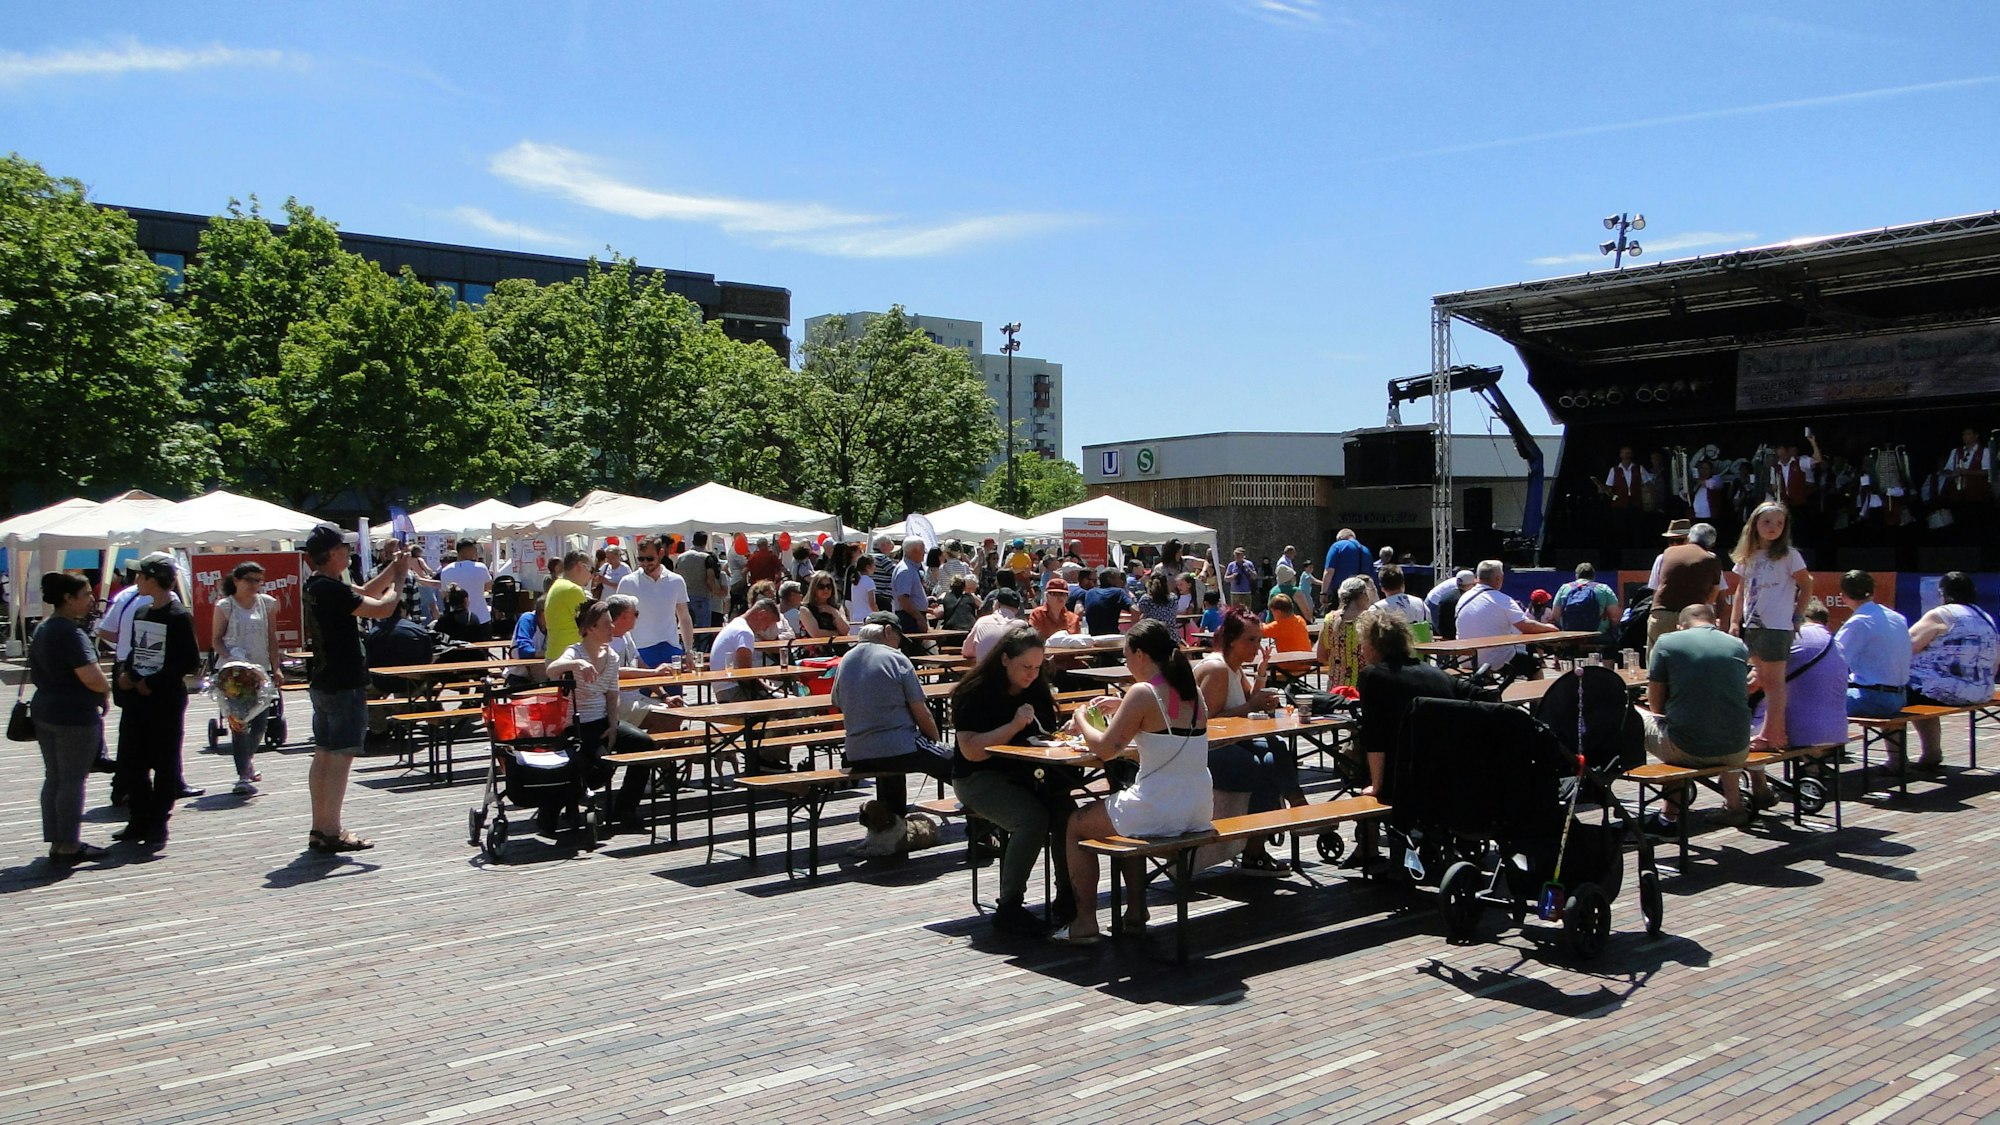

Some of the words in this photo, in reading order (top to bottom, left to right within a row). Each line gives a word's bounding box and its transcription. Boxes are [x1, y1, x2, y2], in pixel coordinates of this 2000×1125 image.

[1103, 452, 1118, 474] U
[1140, 450, 1151, 471] S
[1826, 595, 1848, 607] BE
